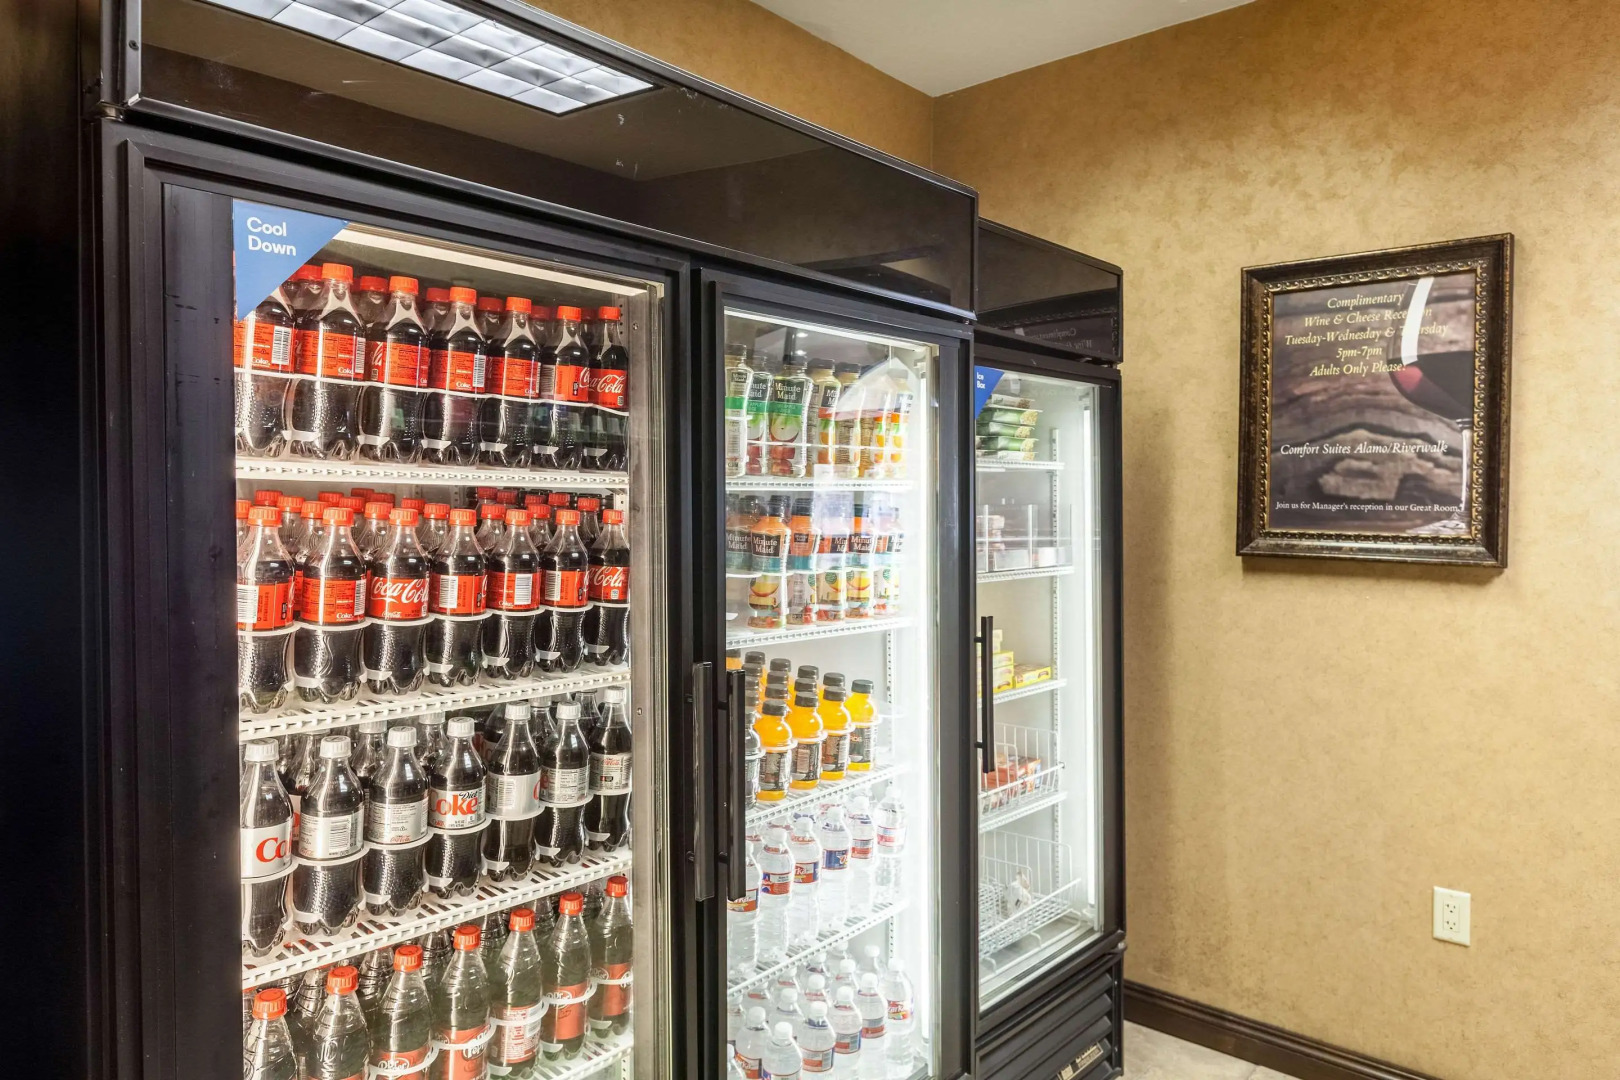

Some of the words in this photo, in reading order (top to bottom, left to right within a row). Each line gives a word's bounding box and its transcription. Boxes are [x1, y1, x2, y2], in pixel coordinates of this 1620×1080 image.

[246, 216, 287, 237] Cool
[248, 234, 297, 257] Down
[1327, 293, 1404, 310] Complimentary
[1304, 316, 1330, 327] Wine
[1333, 314, 1344, 325] &
[1346, 311, 1380, 324] Cheese
[1285, 327, 1382, 346] Tuesday-Wednesday
[1384, 326, 1395, 337] &
[1336, 346, 1383, 361] 5pm-7pm
[1310, 364, 1340, 377] Adults
[1343, 363, 1368, 377] Only
[750, 381, 767, 390] nute
[775, 382, 801, 393] Minute
[976, 380, 986, 389] Box
[748, 390, 762, 398] aid
[777, 390, 797, 400] Maid
[1280, 442, 1319, 457] Comfort
[1322, 443, 1351, 454] Suites
[1354, 440, 1448, 455] Alamo/Riverwalk
[1275, 501, 1290, 510] Join
[1300, 501, 1311, 510] for
[1312, 502, 1349, 513] Manager's
[1350, 503, 1384, 512] reception
[1385, 502, 1393, 511] in
[1410, 503, 1432, 512] Great
[753, 536, 778, 547] Minute
[755, 545, 775, 554] Maid
[428, 788, 478, 816] Coke
[256, 837, 292, 863] Co
